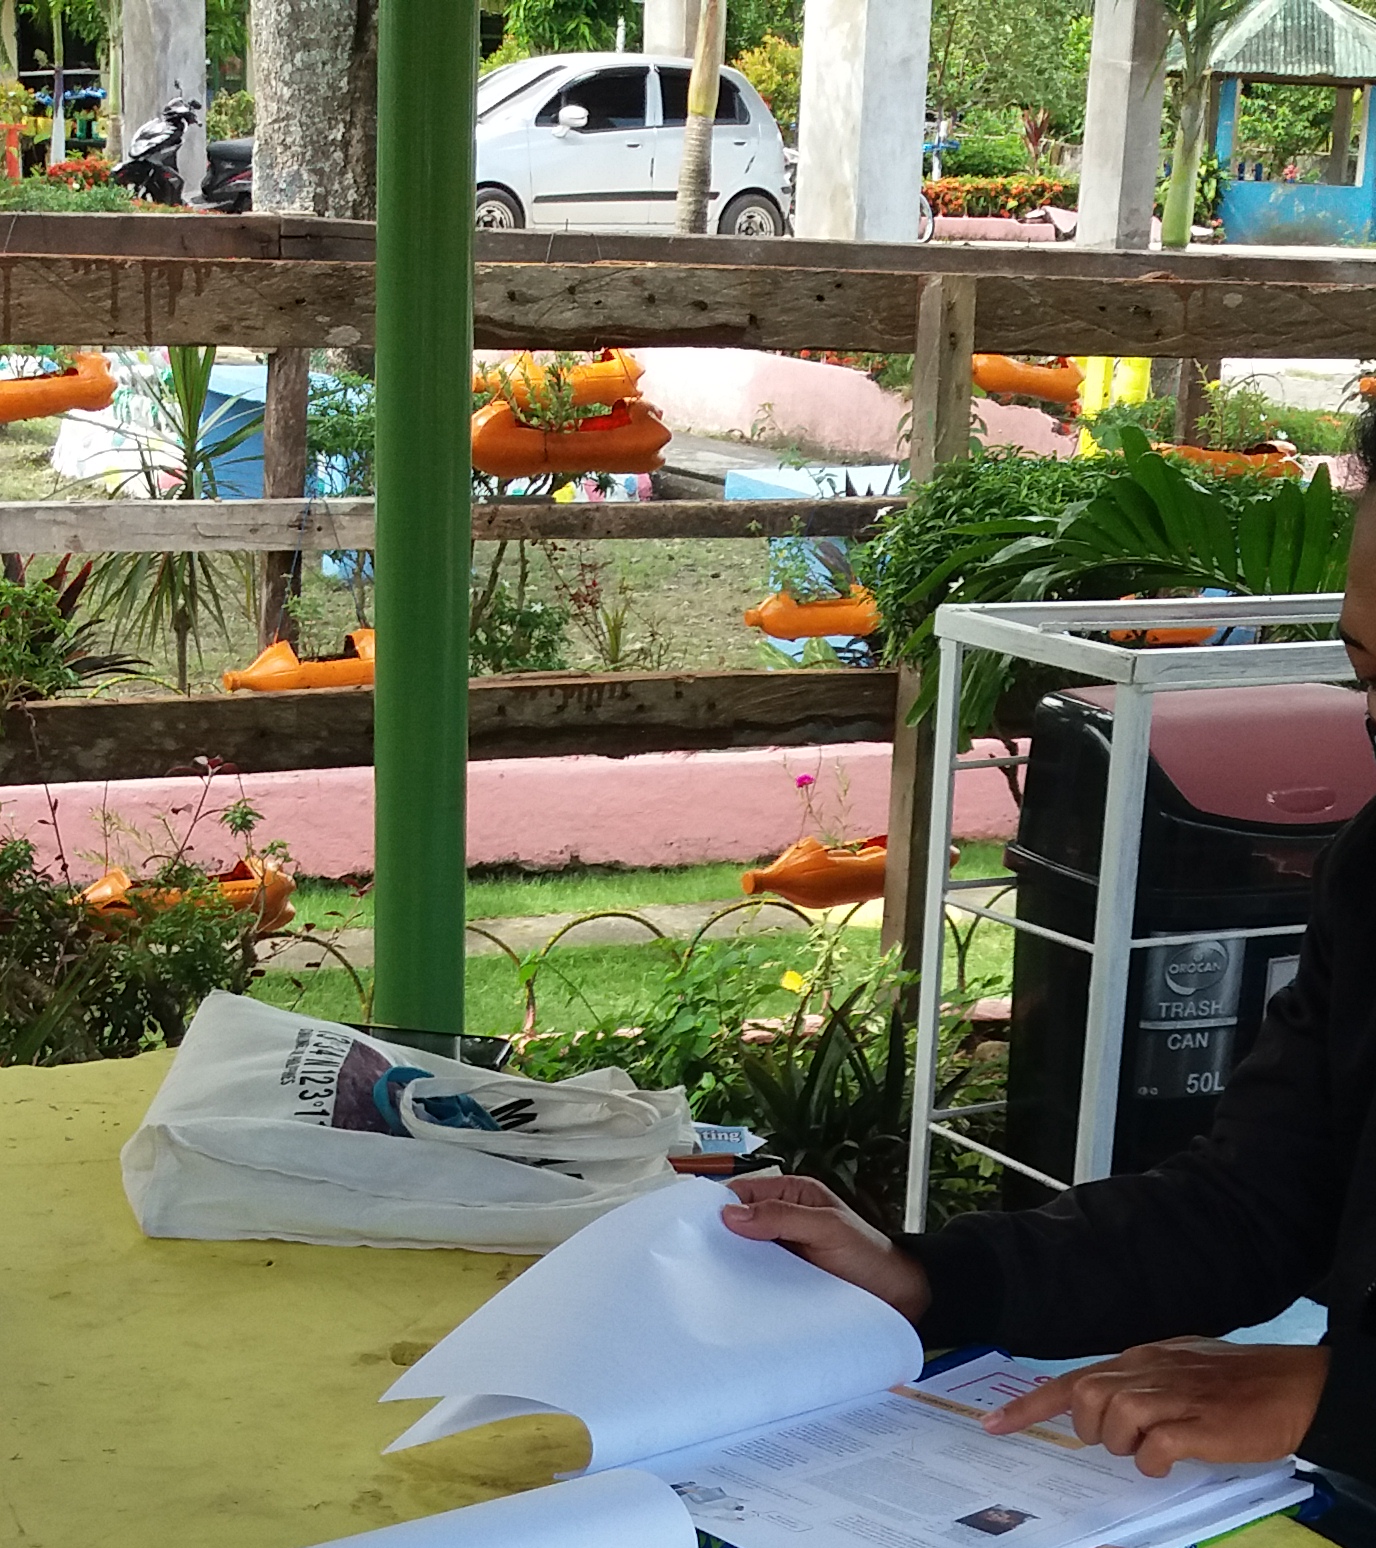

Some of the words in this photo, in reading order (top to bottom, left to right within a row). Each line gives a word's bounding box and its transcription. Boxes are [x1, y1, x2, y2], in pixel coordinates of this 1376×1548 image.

[1169, 962, 1221, 975] OROCAN
[1159, 1001, 1224, 1020] TRASH
[1167, 1033, 1209, 1051] CAN
[1186, 1072, 1226, 1095] 50L
